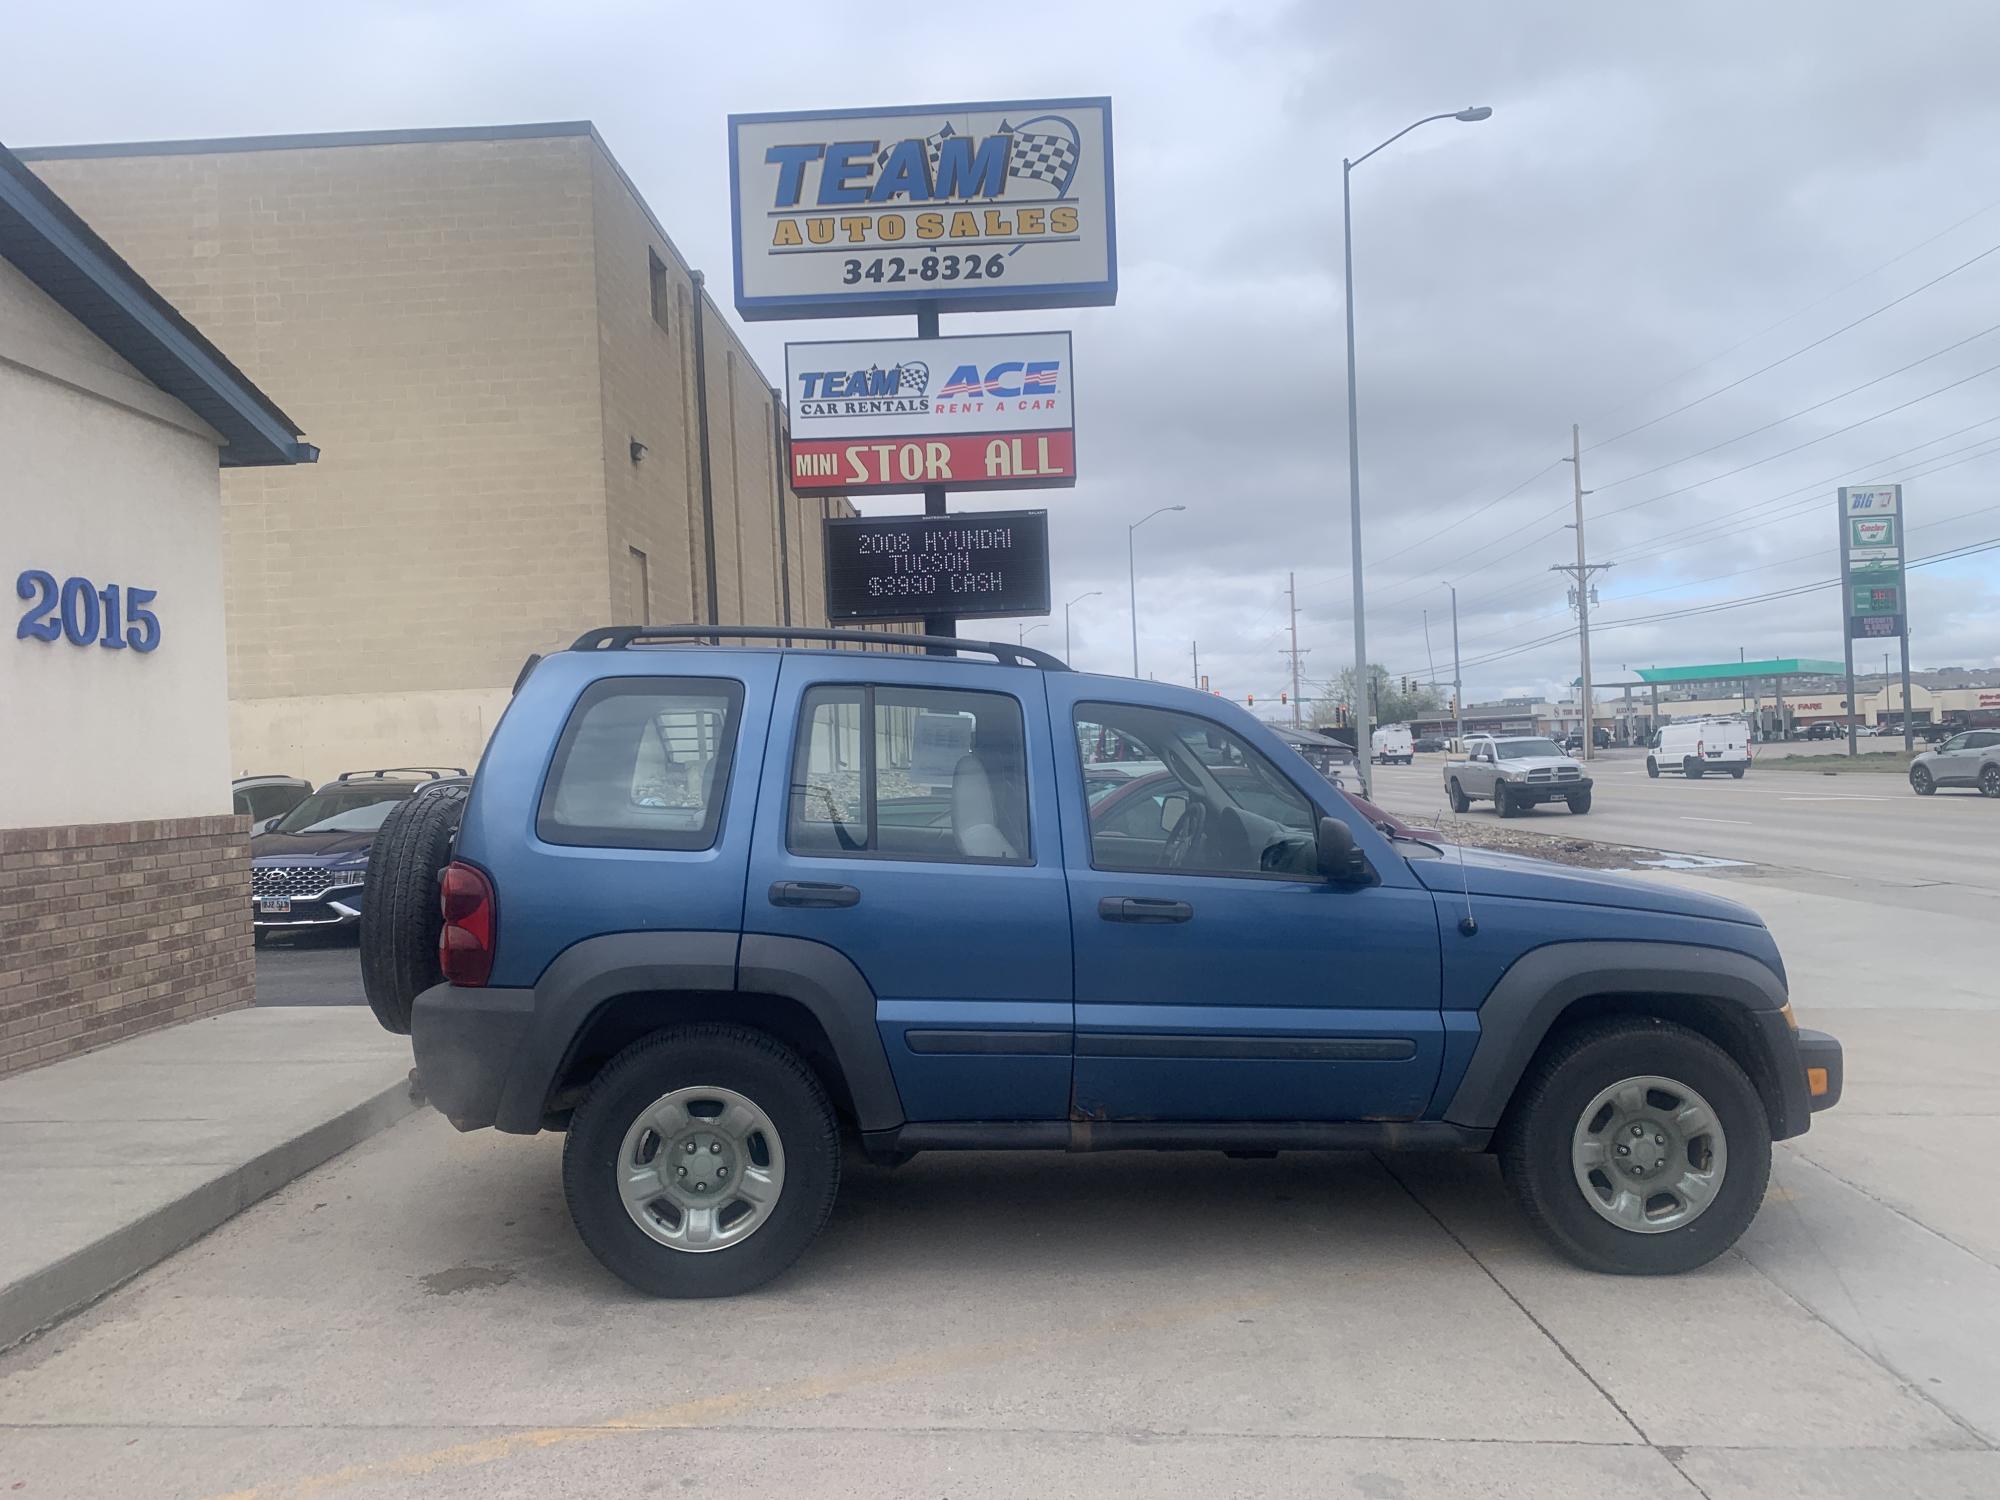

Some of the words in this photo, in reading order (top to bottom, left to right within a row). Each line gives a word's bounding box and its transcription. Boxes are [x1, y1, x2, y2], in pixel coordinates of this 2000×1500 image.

[764, 135, 1014, 208] TEAM
[842, 253, 1005, 285] 342-8326
[799, 367, 901, 399] TEAM
[936, 361, 1060, 398] ACE
[801, 402, 838, 416] CAR
[845, 399, 929, 414] RENTALS
[935, 402, 984, 414] RENT
[995, 402, 1005, 411] A
[1018, 399, 1056, 411] CAR
[796, 453, 838, 477] MINI
[845, 442, 952, 483] STOR
[985, 437, 1063, 477] ALL
[858, 532, 910, 554] 2008
[925, 528, 1011, 551] HYUNDAI
[888, 551, 970, 574] TUCSON
[868, 575, 936, 596] $3990
[950, 571, 1002, 592] CASH
[16, 569, 161, 653] 2015
